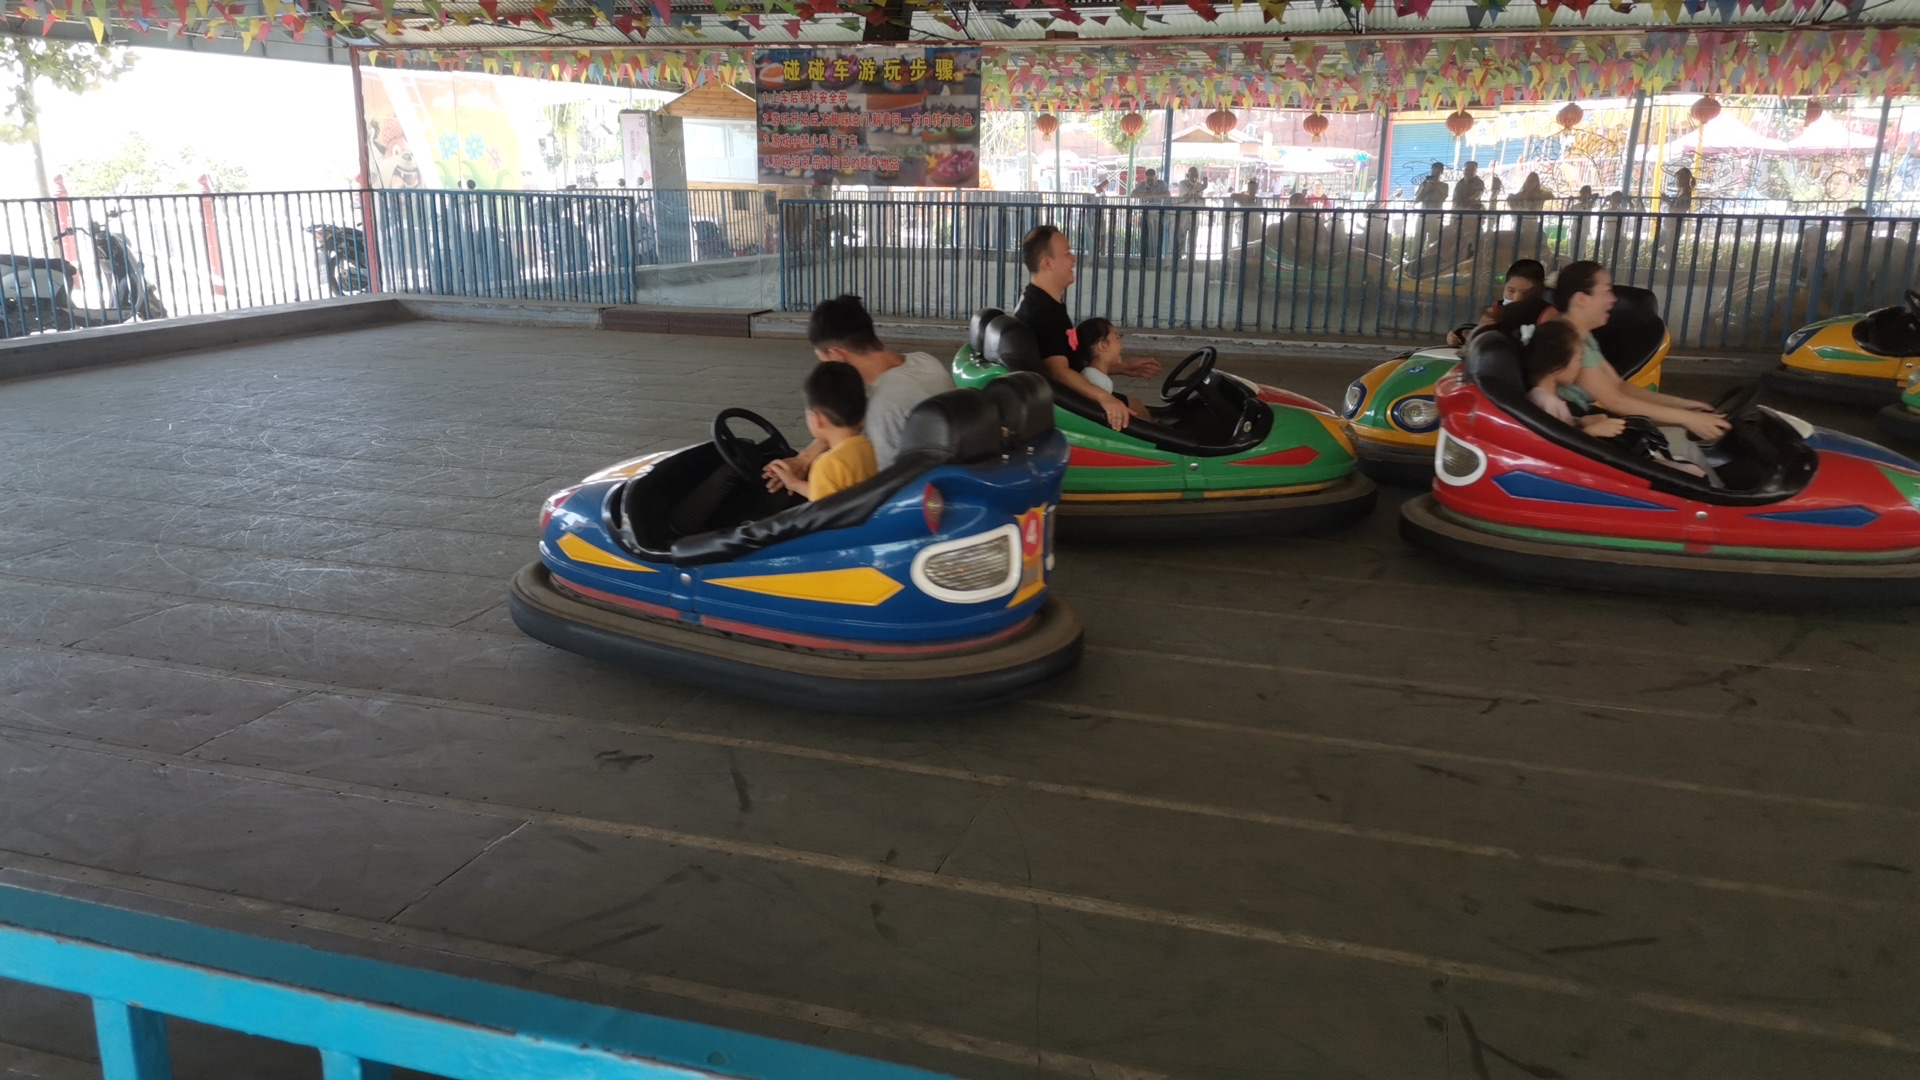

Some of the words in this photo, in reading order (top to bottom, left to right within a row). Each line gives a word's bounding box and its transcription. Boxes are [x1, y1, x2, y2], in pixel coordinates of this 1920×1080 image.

[783, 58, 956, 82] 碰碰车游玩步骤
[762, 90, 848, 105] 1.上车后系好安全带
[763, 133, 858, 149] 3.游戏中禁止私自下车
